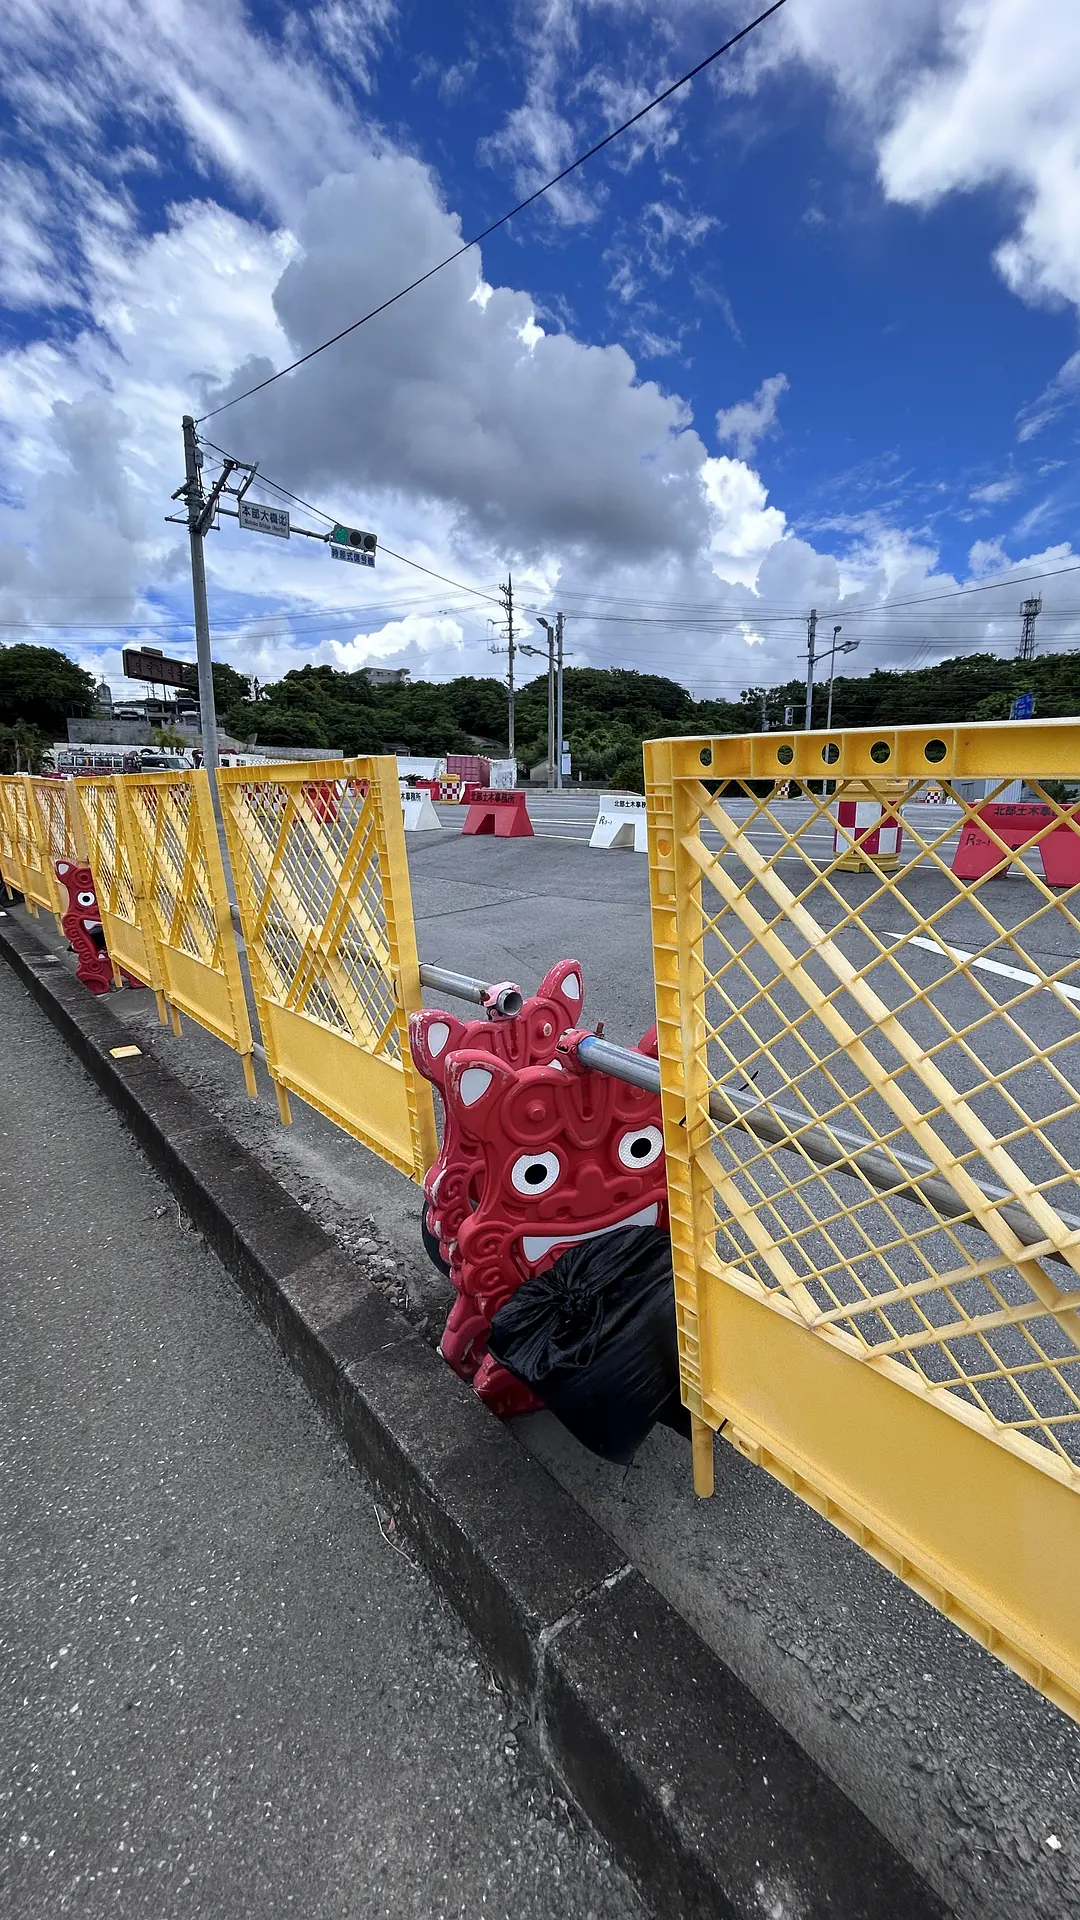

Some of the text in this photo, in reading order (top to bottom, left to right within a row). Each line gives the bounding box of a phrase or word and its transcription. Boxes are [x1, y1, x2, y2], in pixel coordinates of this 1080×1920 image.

[471, 791, 515, 804] 北部土木事務所
